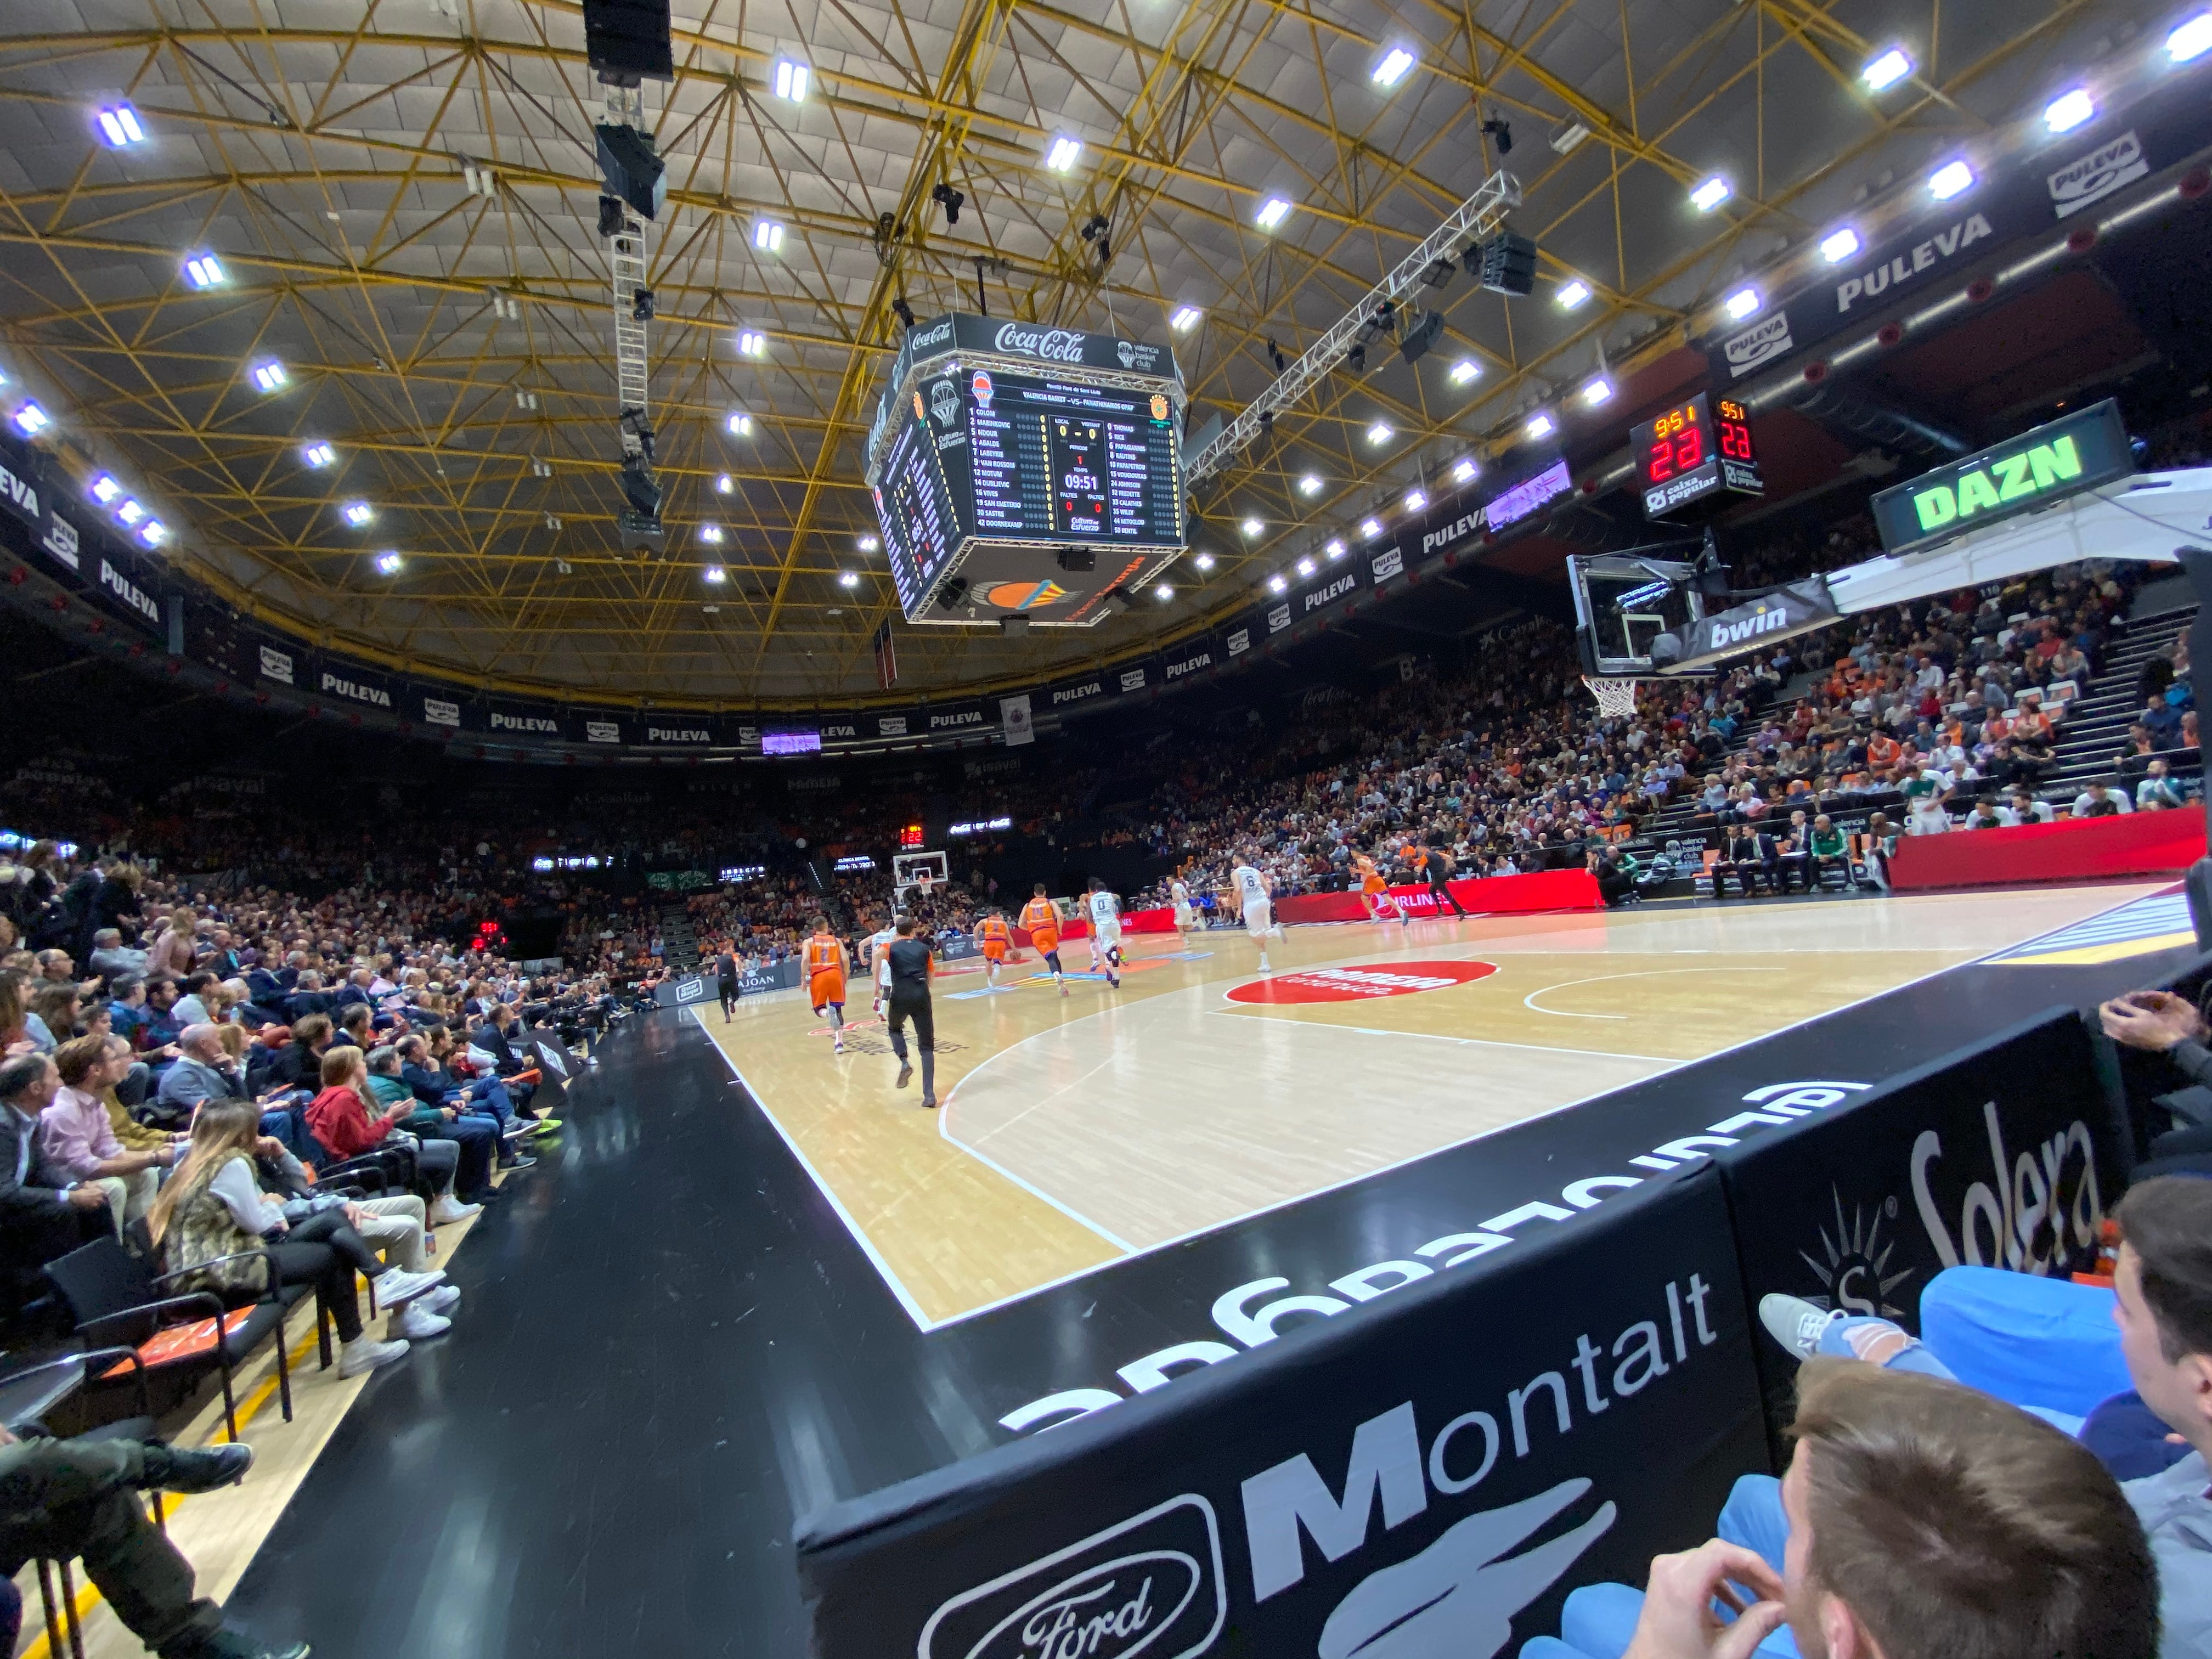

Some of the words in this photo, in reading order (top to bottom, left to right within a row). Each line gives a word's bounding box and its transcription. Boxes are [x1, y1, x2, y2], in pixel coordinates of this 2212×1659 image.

[2053, 141, 2134, 191] PULEVA
[1837, 213, 1993, 313] PULEVA
[912, 322, 951, 350] Coca-Cola
[995, 323, 1085, 362] Coca-Cola
[1730, 319, 1784, 356] PULEVA
[1134, 344, 1159, 355] valencia
[1135, 352, 1156, 362] basket
[1136, 359, 1151, 368] club
[1023, 392, 1047, 401] VALENCIA
[969, 407, 974, 415] 1
[976, 409, 995, 417] COLOM
[1655, 405, 1695, 438] 9:51
[939, 431, 958, 443] Cultura
[1059, 425, 1066, 436] 0
[1088, 428, 1096, 439] 0
[939, 437, 965, 450] Esfuerzo
[1077, 455, 1083, 465] 1
[1065, 474, 1097, 490] 09:51
[1667, 476, 1699, 495] caixa
[1668, 475, 1718, 504] popular
[1914, 435, 2083, 531] DAZN
[0, 465, 40, 517] EVA
[1066, 501, 1073, 511] 0
[1094, 504, 1101, 512] 0
[1423, 506, 1487, 554] PULEVA
[1374, 551, 1399, 569] PULEVA
[101, 558, 158, 622] PULEVA
[1305, 574, 1355, 611] PULEVA
[1616, 580, 1667, 602] PORSCH
[1269, 607, 1288, 620] PULEVA
[1711, 606, 1787, 648] bwin
[1229, 633, 1246, 645] PULEVA
[1719, 644, 1763, 657] bwin
[1166, 653, 1211, 679] PULEVA
[321, 673, 391, 707] PULEVA
[1053, 682, 1101, 704] PULEVA
[491, 713, 558, 732] PULEVA
[930, 712, 983, 727] PULEVA
[648, 728, 711, 741] PULEVA
[821, 726, 855, 736] LEVA
[908, 832, 922, 842] 22
[1680, 836, 1707, 845] valencia
[1682, 844, 1703, 853] basket
[1246, 876, 1255, 887] 6
[1098, 900, 1105, 910] 0
[681, 983, 697, 992] Oscar
[681, 987, 699, 998] Mayer
[1910, 1101, 2103, 1277] Solera
[1242, 1272, 1718, 1602] Montalt
[1018, 1577, 1152, 1659] Ford
